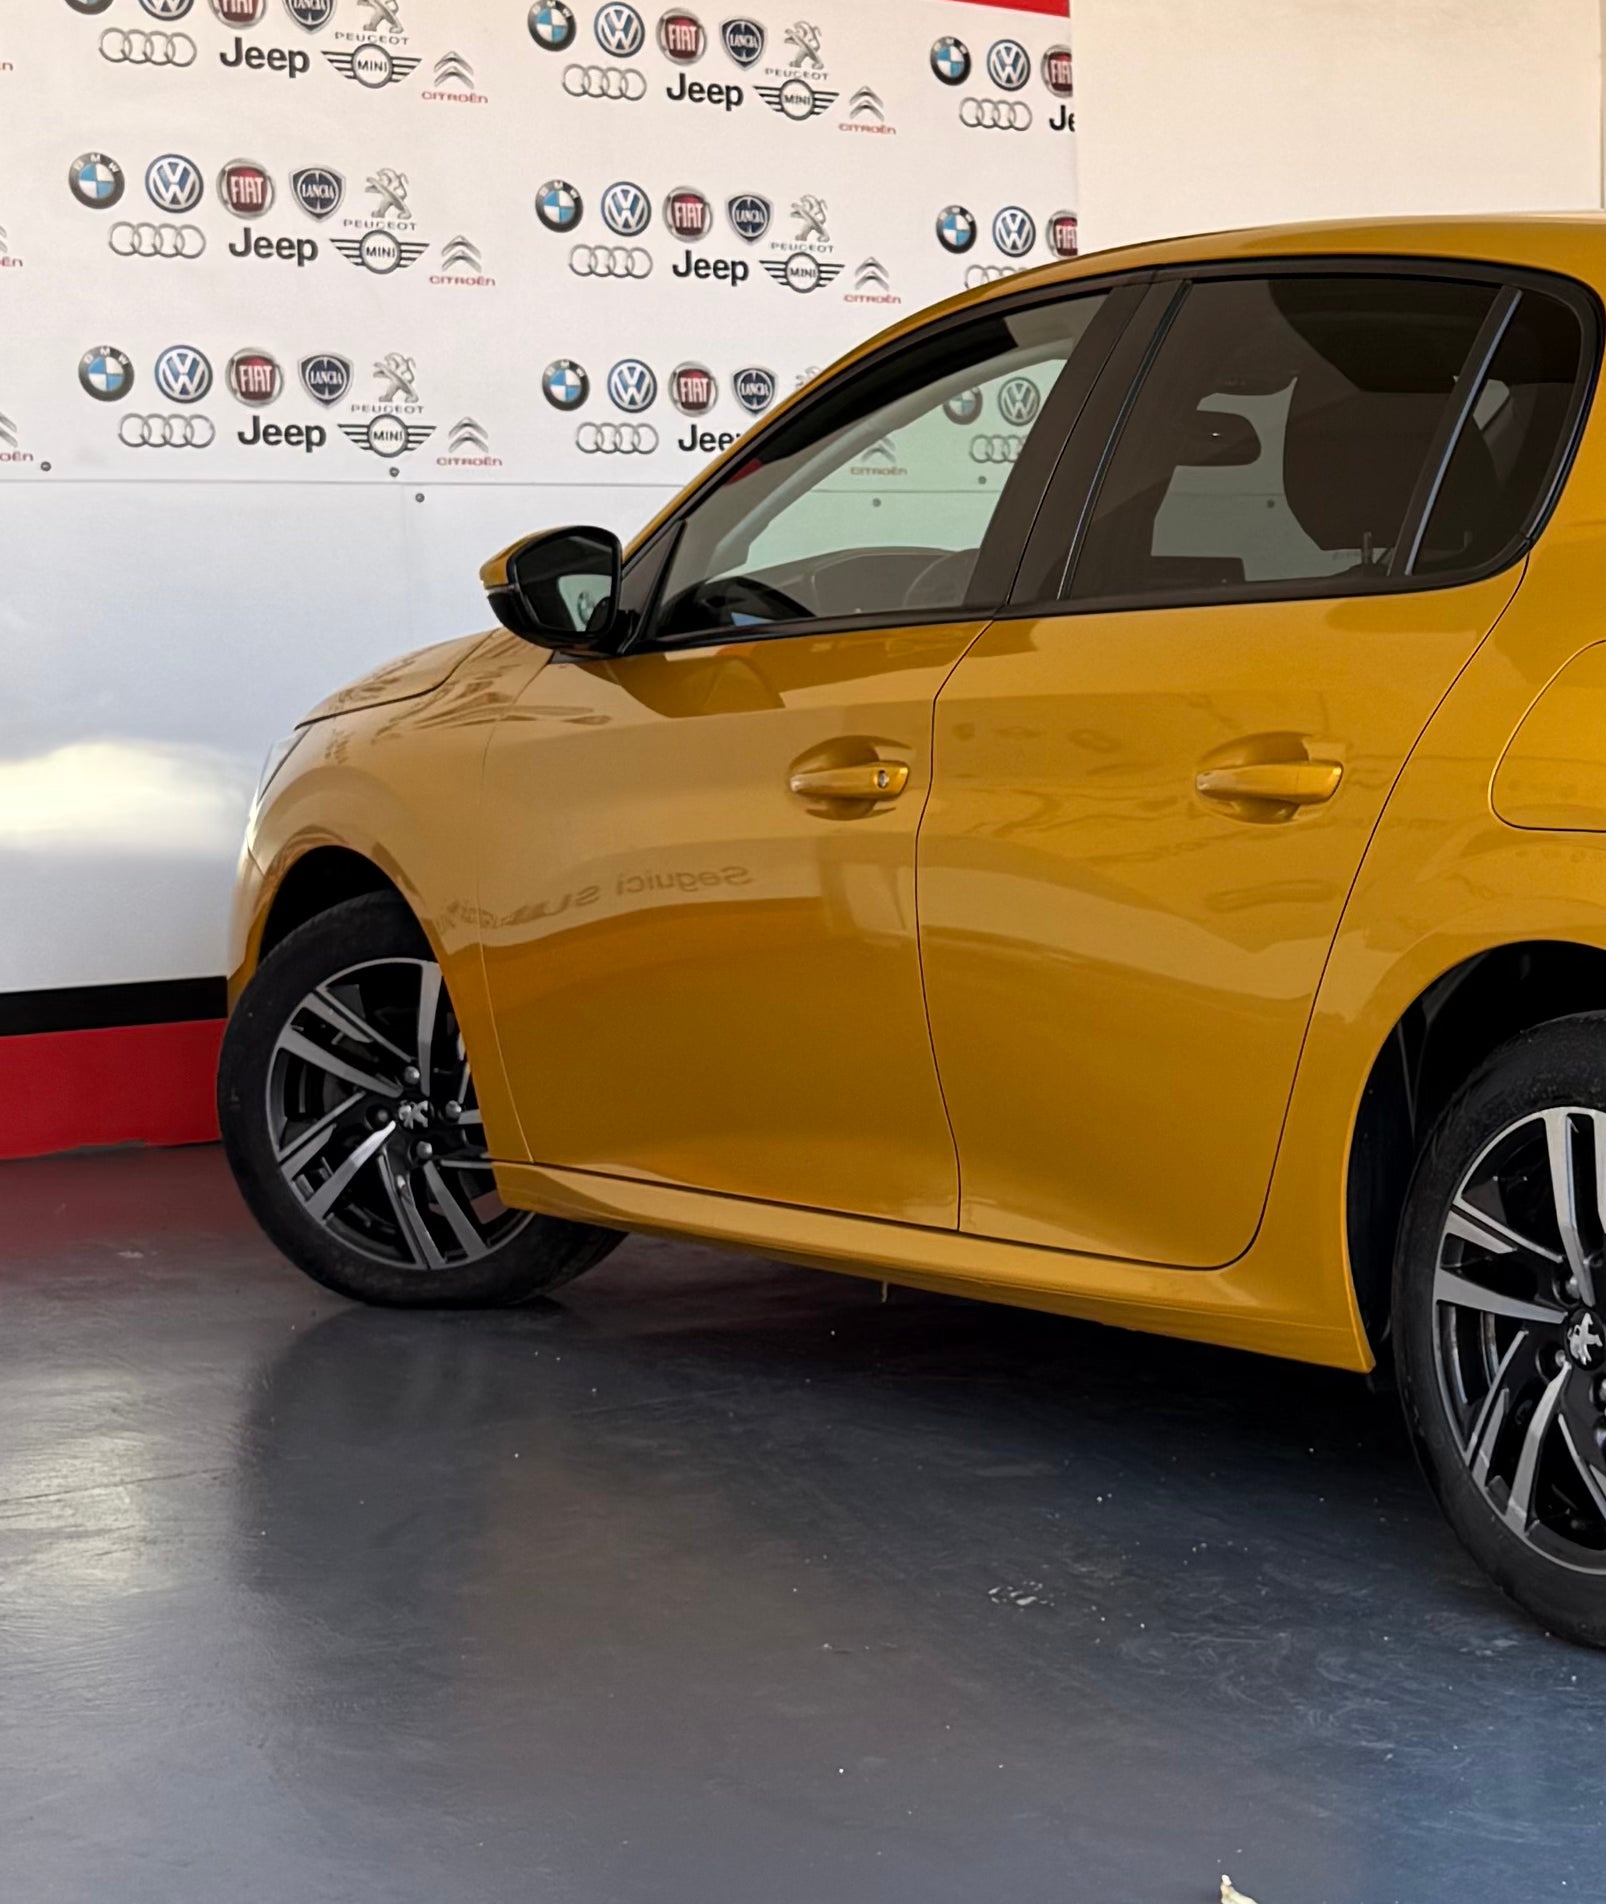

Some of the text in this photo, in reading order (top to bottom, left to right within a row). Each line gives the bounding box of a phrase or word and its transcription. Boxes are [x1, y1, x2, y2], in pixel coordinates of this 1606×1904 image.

[668, 24, 698, 51] FIAT
[220, 37, 310, 78] Jeep
[357, 59, 388, 72] MINI
[1050, 59, 1073, 85] FIA
[666, 72, 744, 111] Jeep
[784, 94, 811, 106] MINI
[230, 176, 264, 204] FIAT
[674, 202, 703, 228] FIAT
[229, 227, 318, 267] Jeep
[1056, 224, 1078, 249] FIA
[366, 247, 395, 258] MINI
[672, 250, 749, 287] Jeep
[790, 268, 816, 278] MINI
[239, 365, 272, 393] FIAT
[680, 377, 709, 403] FIAT
[238, 415, 327, 453] Jeep
[373, 430, 402, 442] MINI
[677, 424, 741, 453] Jee
